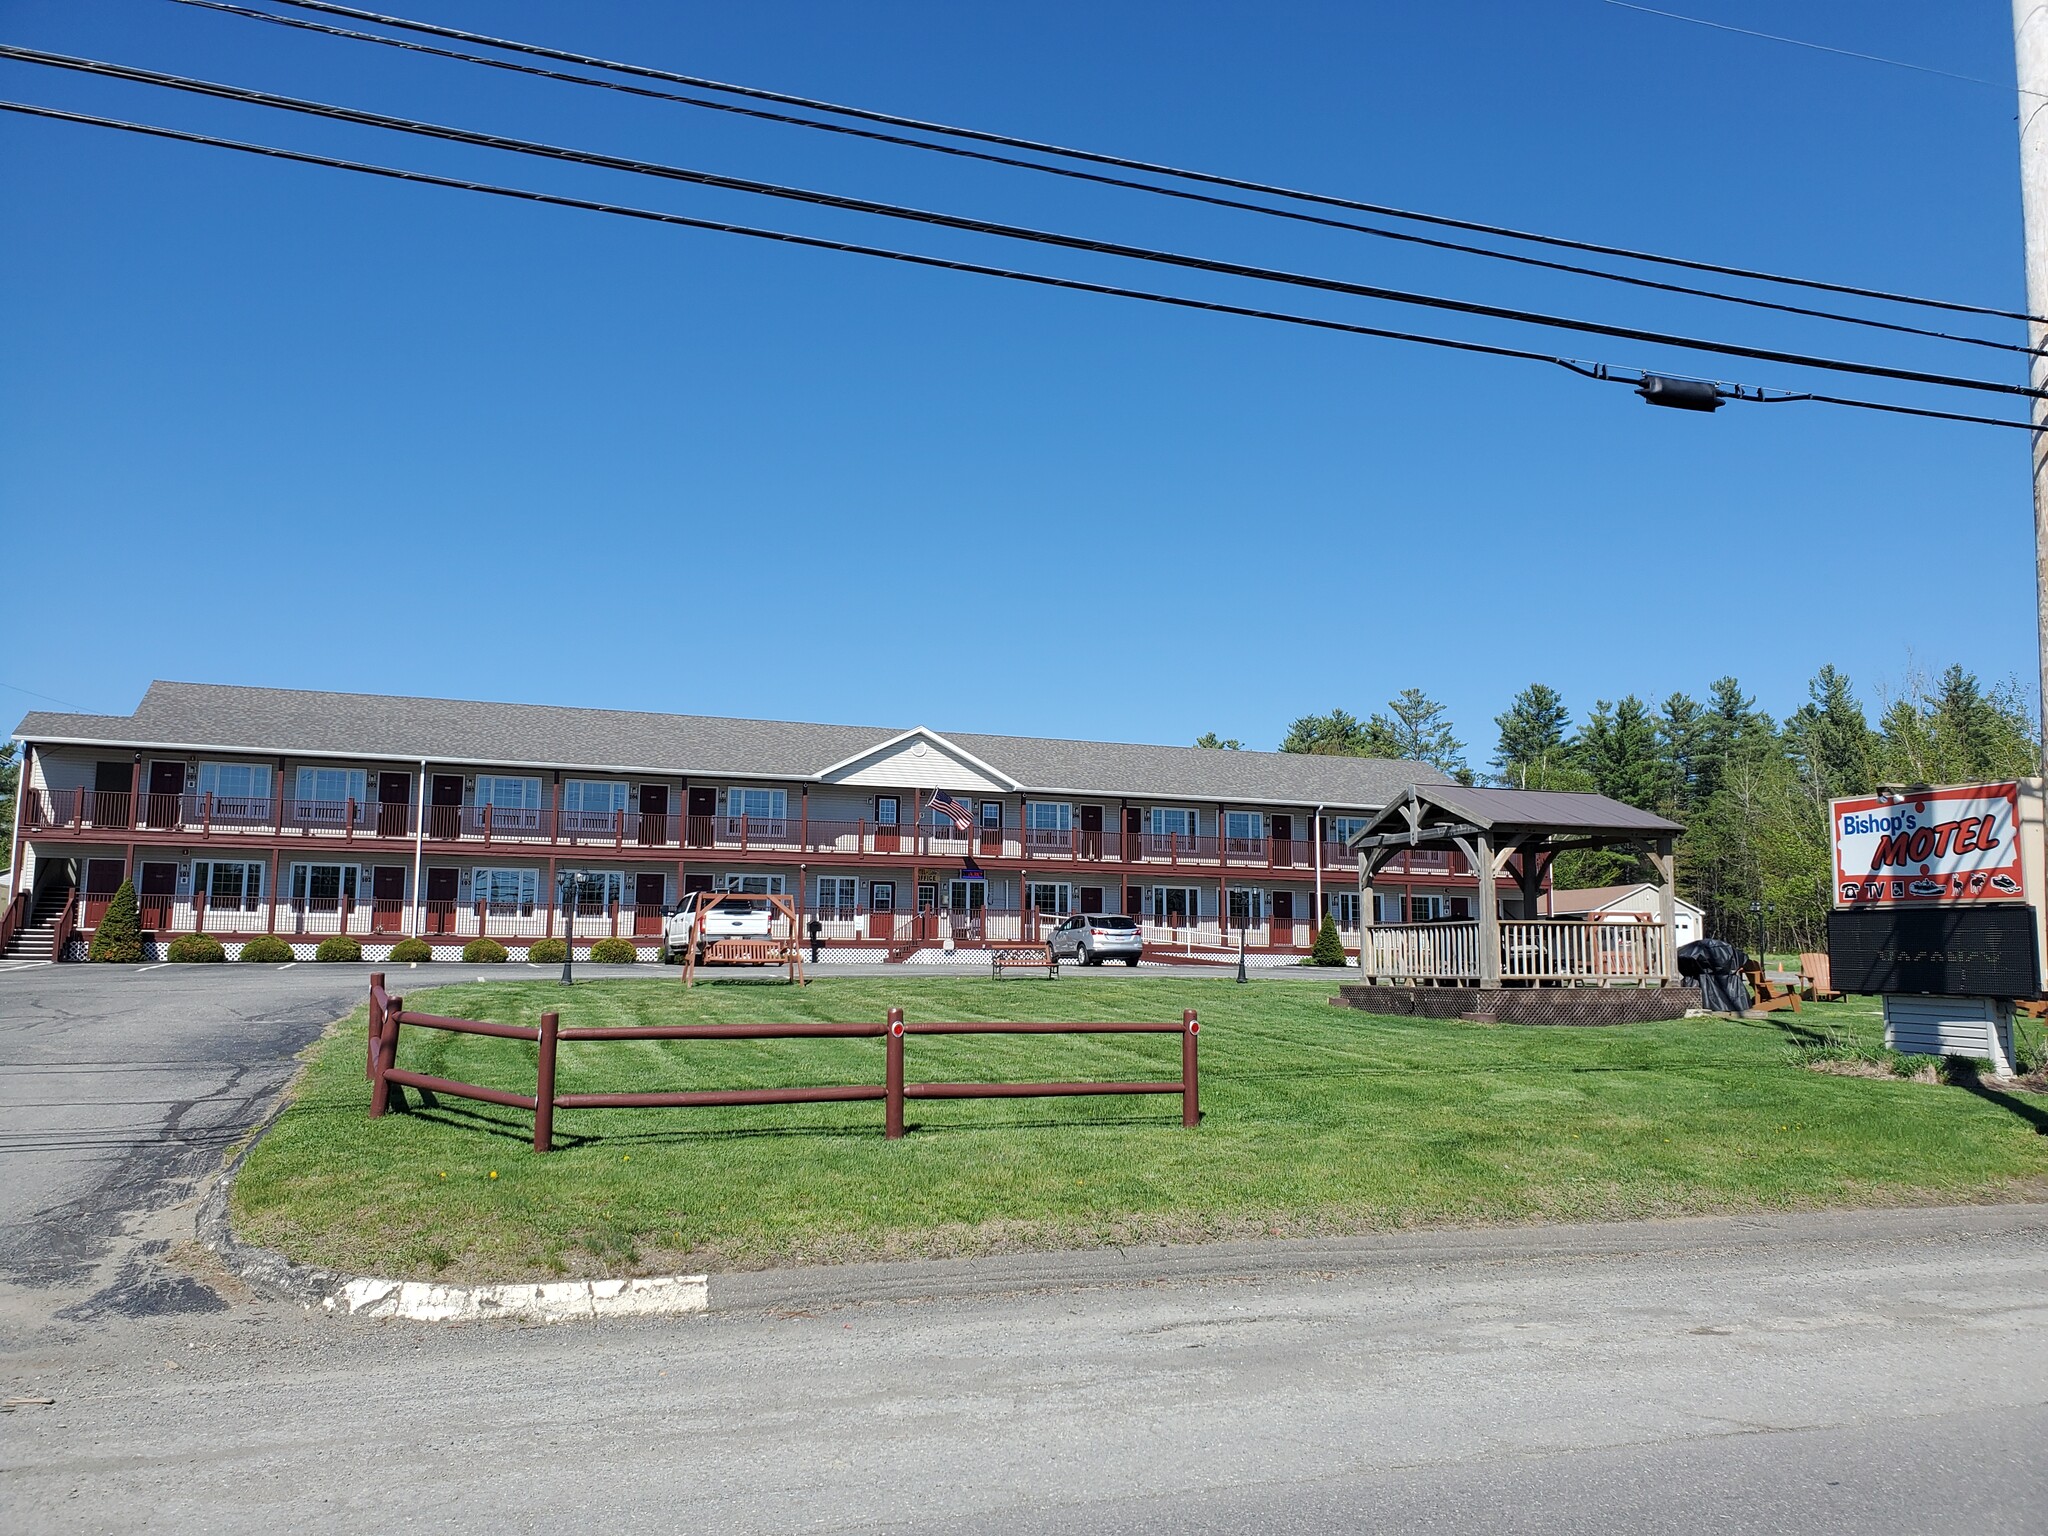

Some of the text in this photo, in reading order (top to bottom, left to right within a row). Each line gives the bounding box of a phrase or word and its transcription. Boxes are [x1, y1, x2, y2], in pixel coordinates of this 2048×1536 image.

[1844, 810, 1917, 836] Bishop's
[1871, 814, 2000, 870] MOTEL
[1866, 882, 1885, 898] TV
